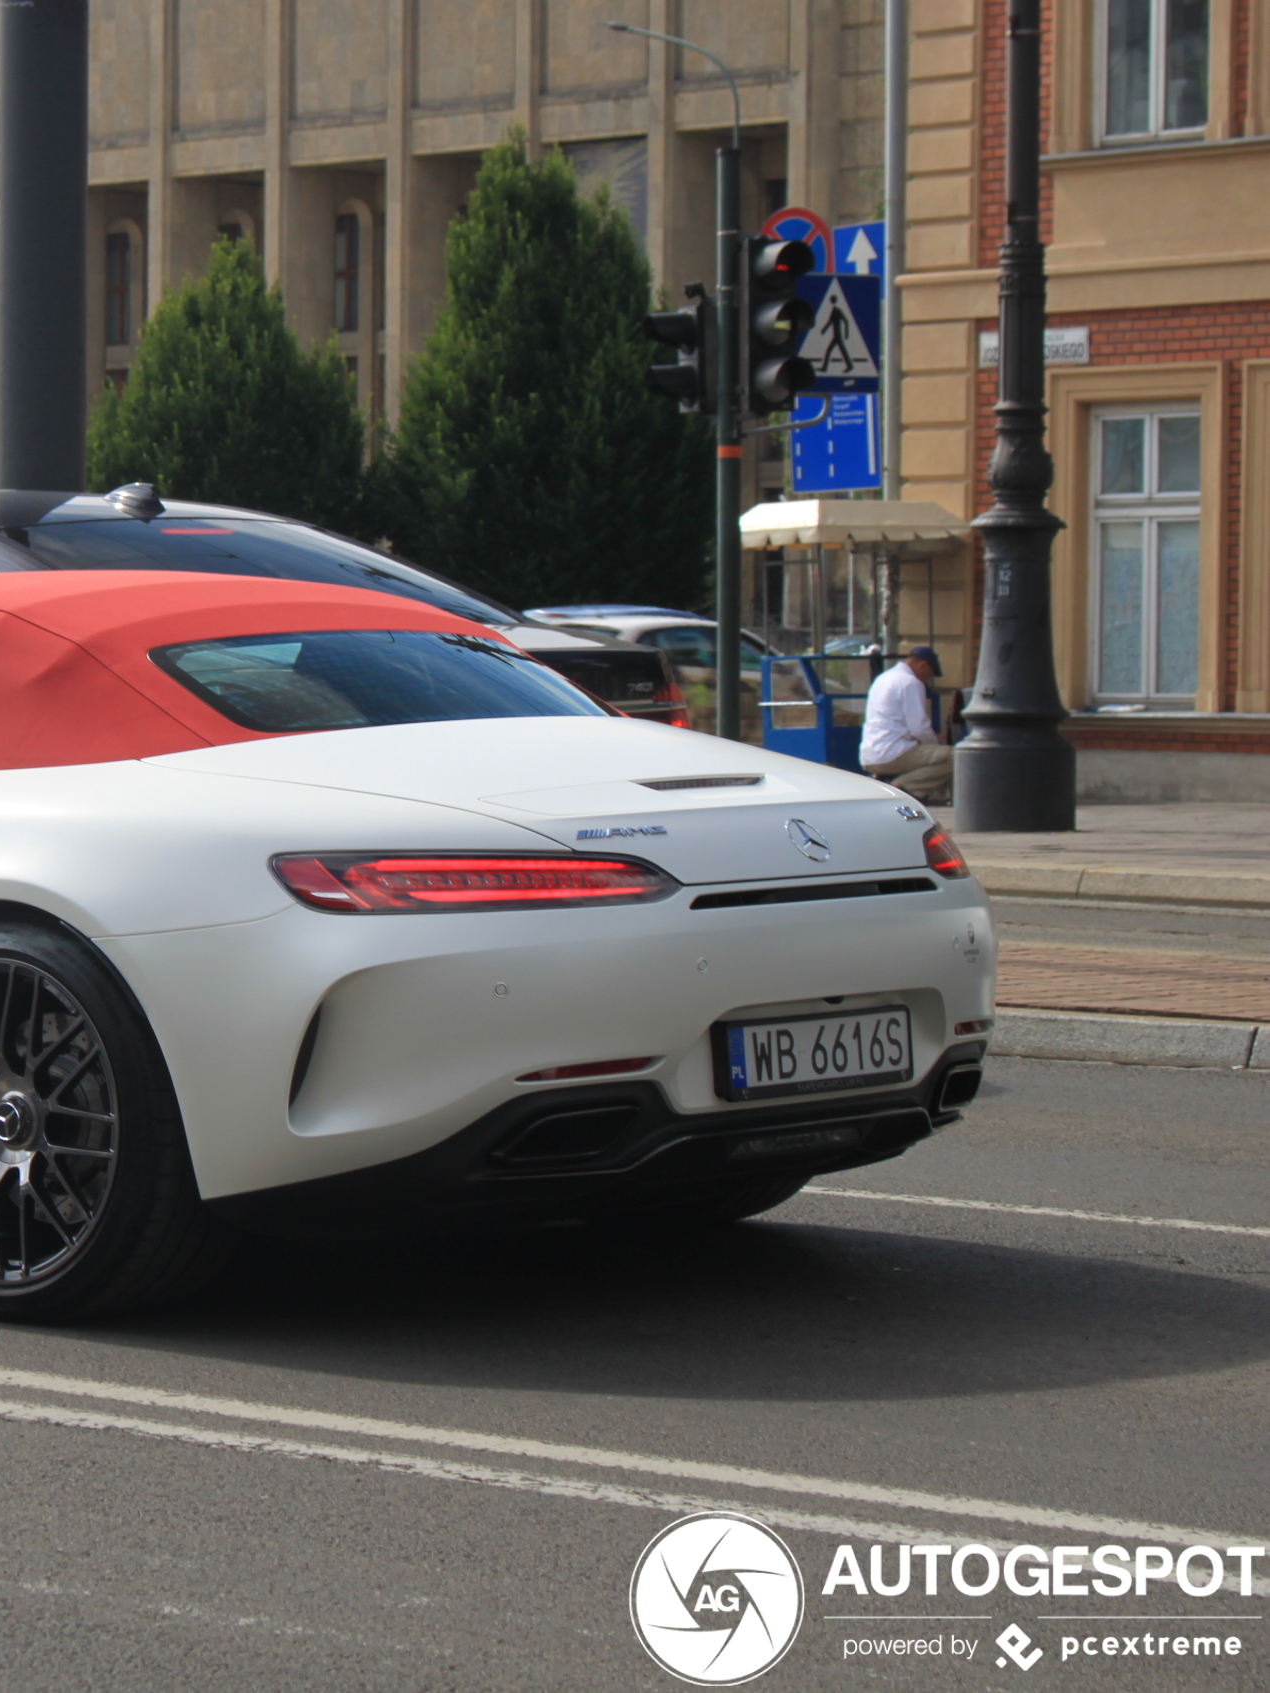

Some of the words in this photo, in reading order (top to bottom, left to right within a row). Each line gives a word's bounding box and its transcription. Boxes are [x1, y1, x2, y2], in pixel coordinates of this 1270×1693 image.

[752, 1028, 797, 1083] WB
[811, 1016, 903, 1075] 6616S
[732, 1065, 745, 1080] PL
